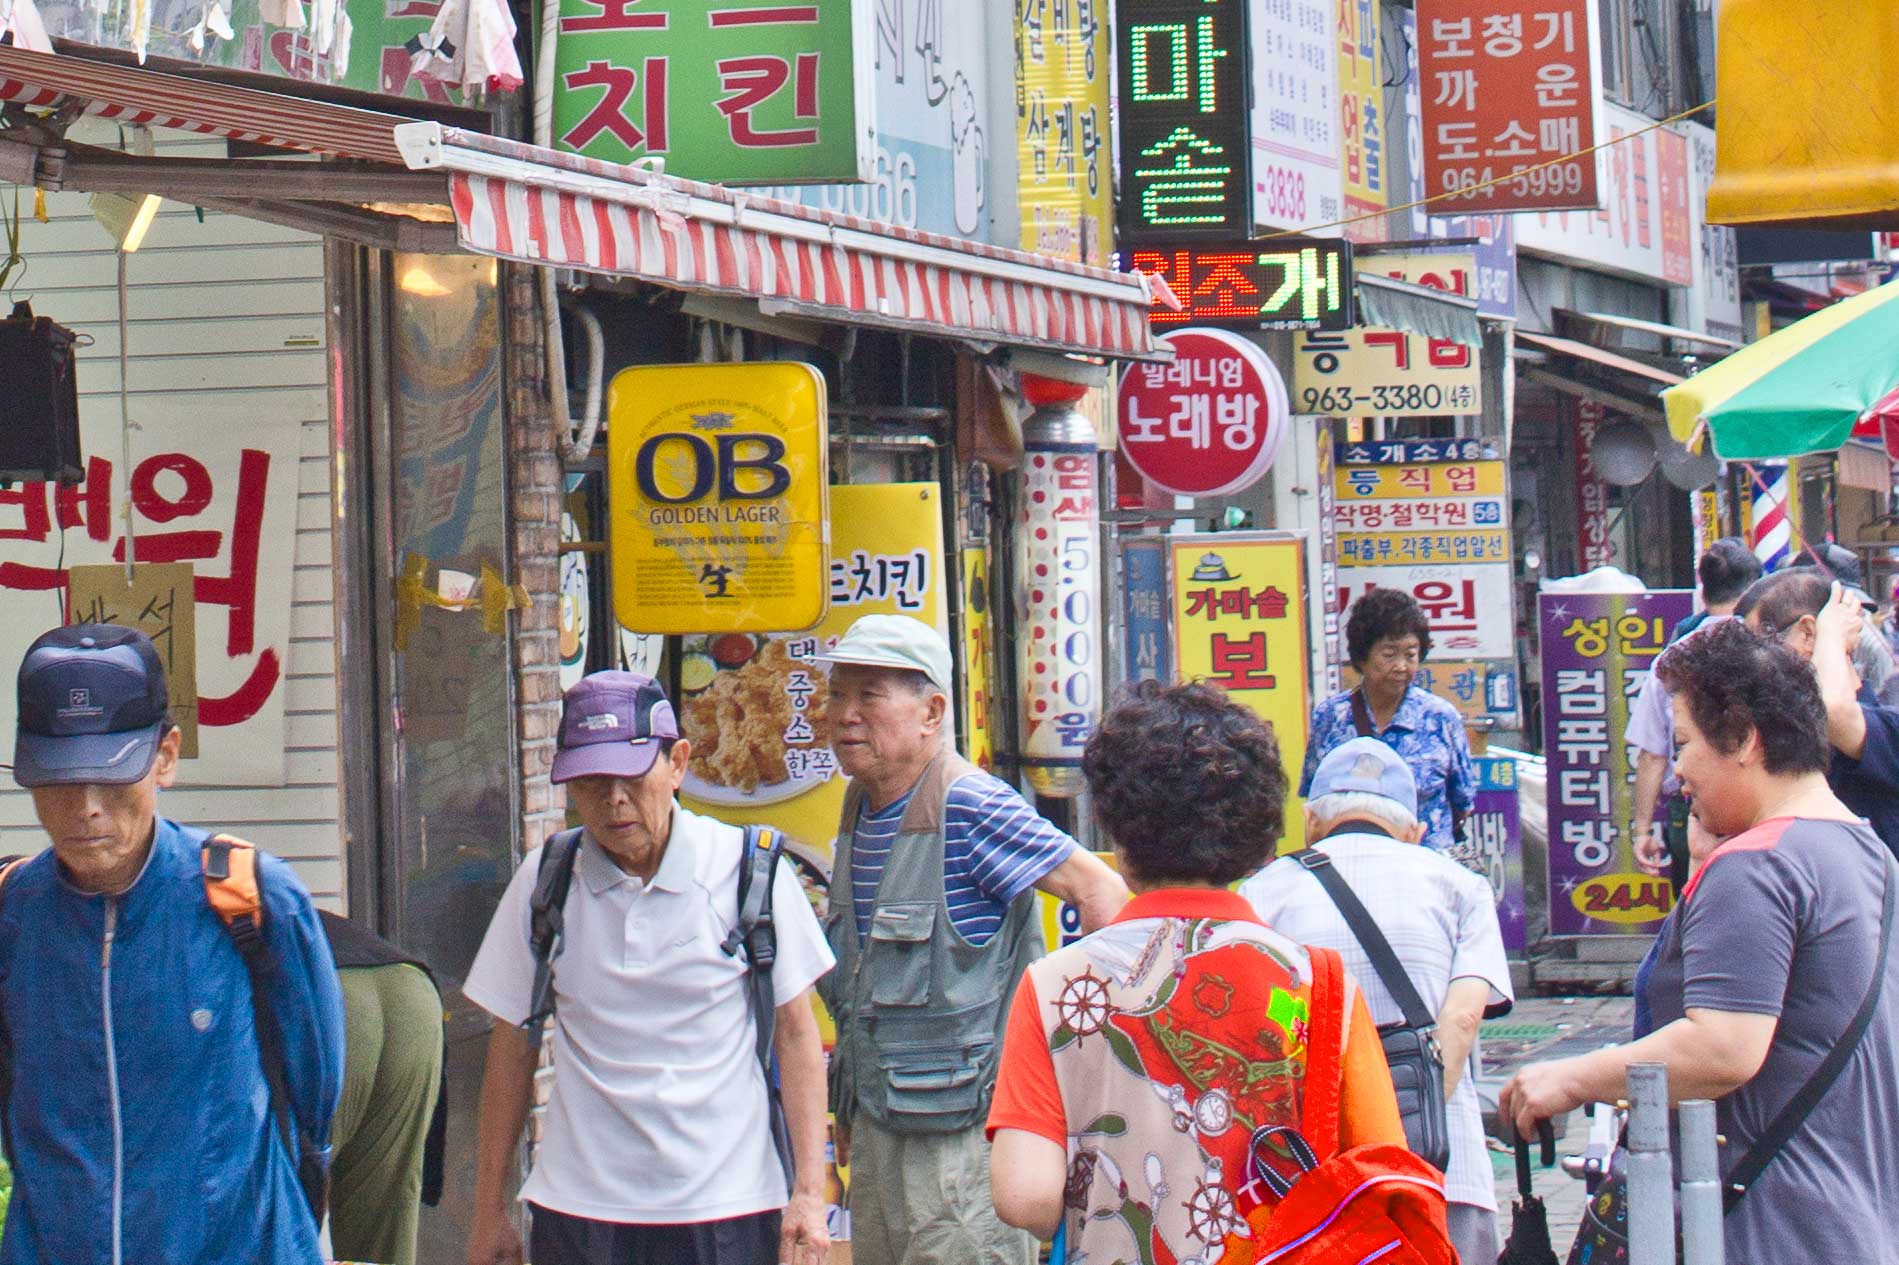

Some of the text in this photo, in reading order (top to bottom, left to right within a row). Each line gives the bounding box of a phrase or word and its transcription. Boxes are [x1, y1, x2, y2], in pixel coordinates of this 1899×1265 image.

[1432, 11, 1574, 58] 보청기
[560, 52, 820, 152] 치킨
[1442, 163, 1582, 200] 964-5999
[1303, 384, 1441, 412] 963-3380
[1127, 393, 1260, 450] 노래방
[635, 432, 791, 503] OB
[1347, 466, 1476, 496] 등 직업
[650, 506, 780, 525] GOLDEN LAGER
[1186, 586, 1288, 620] 가마솥
[1562, 616, 1664, 657] 성인
[787, 674, 814, 708] 중
[786, 716, 812, 741] 소
[1557, 669, 1619, 868] 컴퓨터방
[1584, 880, 1670, 912] 24시
